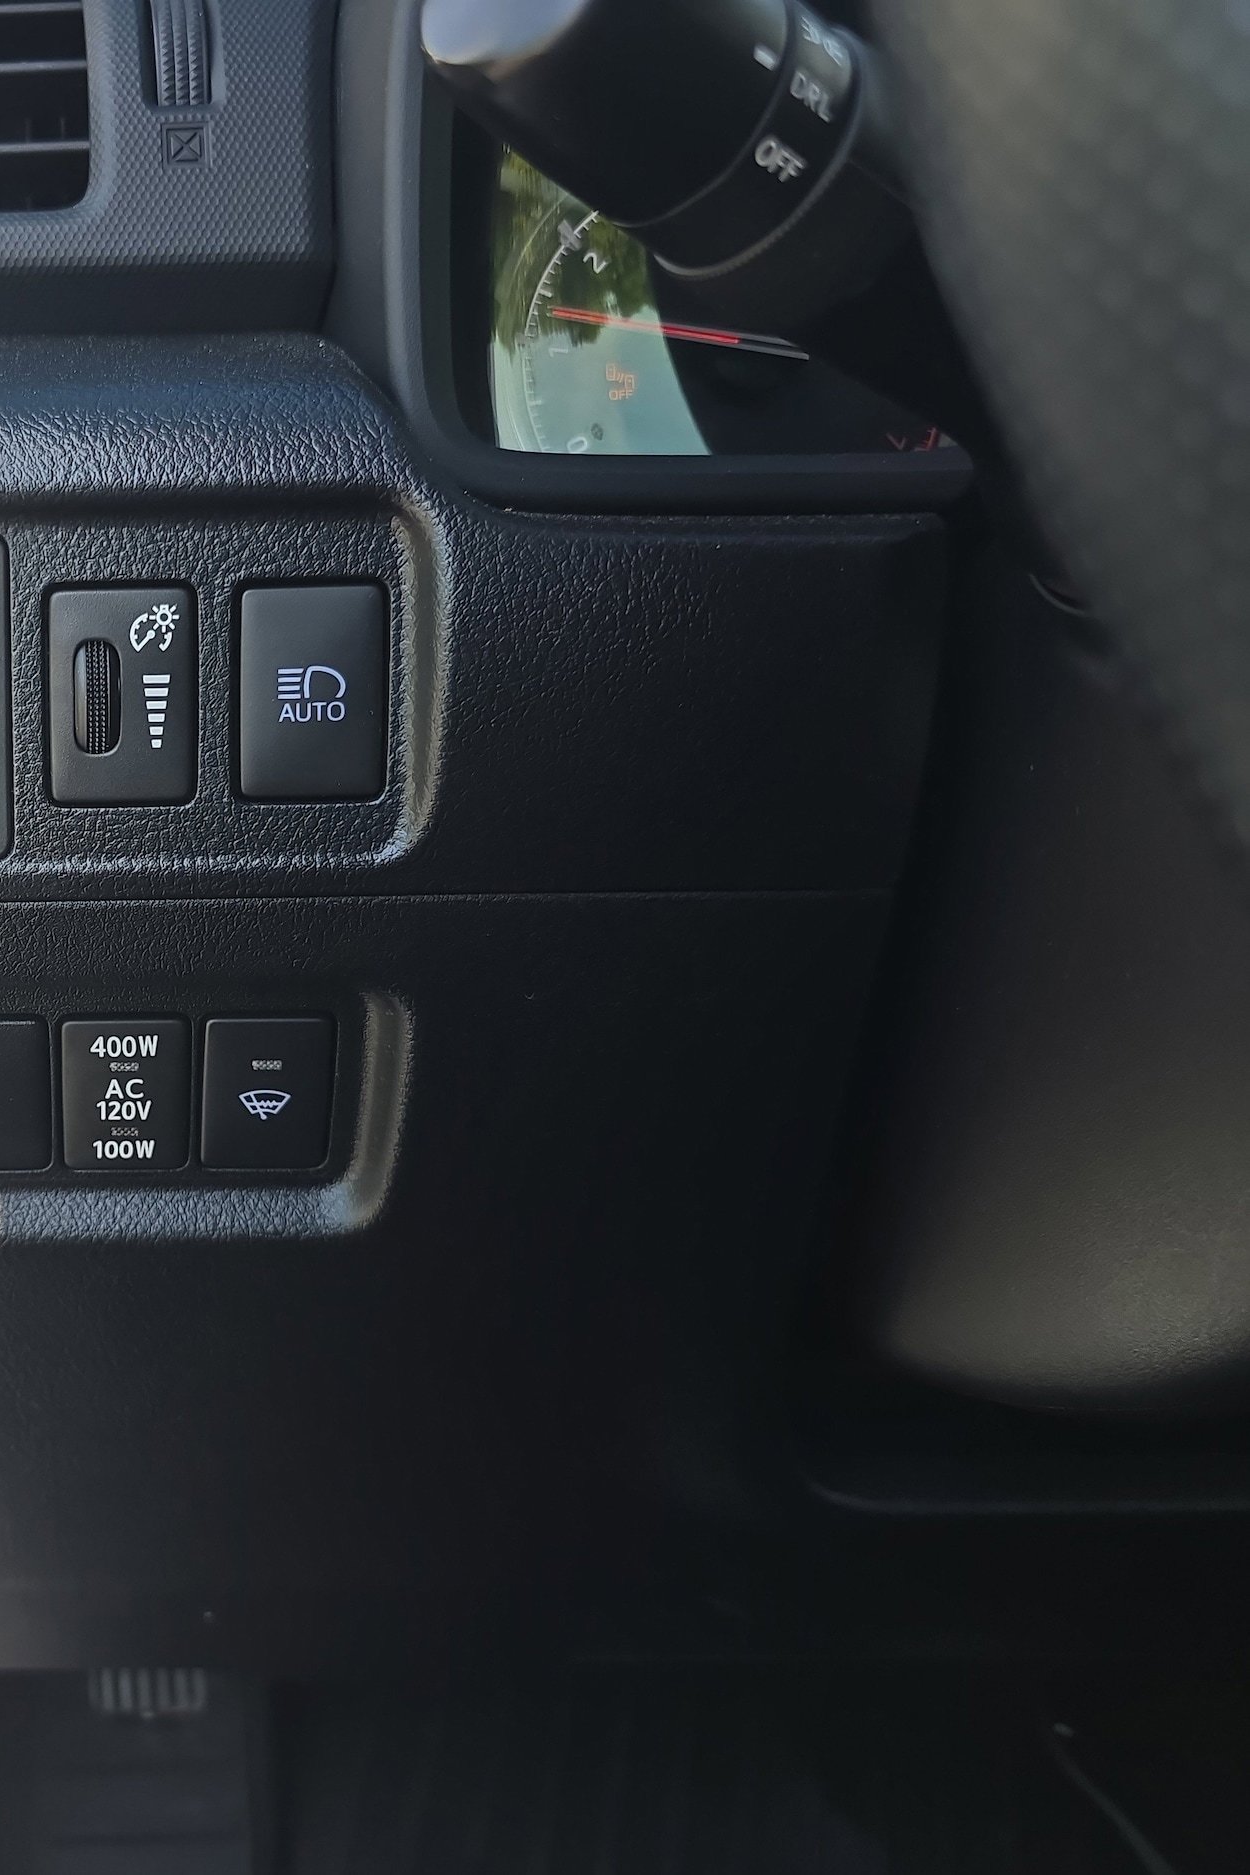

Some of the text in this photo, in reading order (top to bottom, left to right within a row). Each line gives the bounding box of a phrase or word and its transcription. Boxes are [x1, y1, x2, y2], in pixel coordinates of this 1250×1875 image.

[790, 70, 831, 123] DRL
[754, 138, 806, 183] OFF
[582, 252, 609, 274] 2
[609, 390, 633, 400] OFF
[277, 701, 346, 723] AUTO
[90, 1034, 159, 1058] 400W
[104, 1078, 145, 1100] AC
[96, 1100, 152, 1121] 120V
[92, 1139, 155, 1160] 100W
